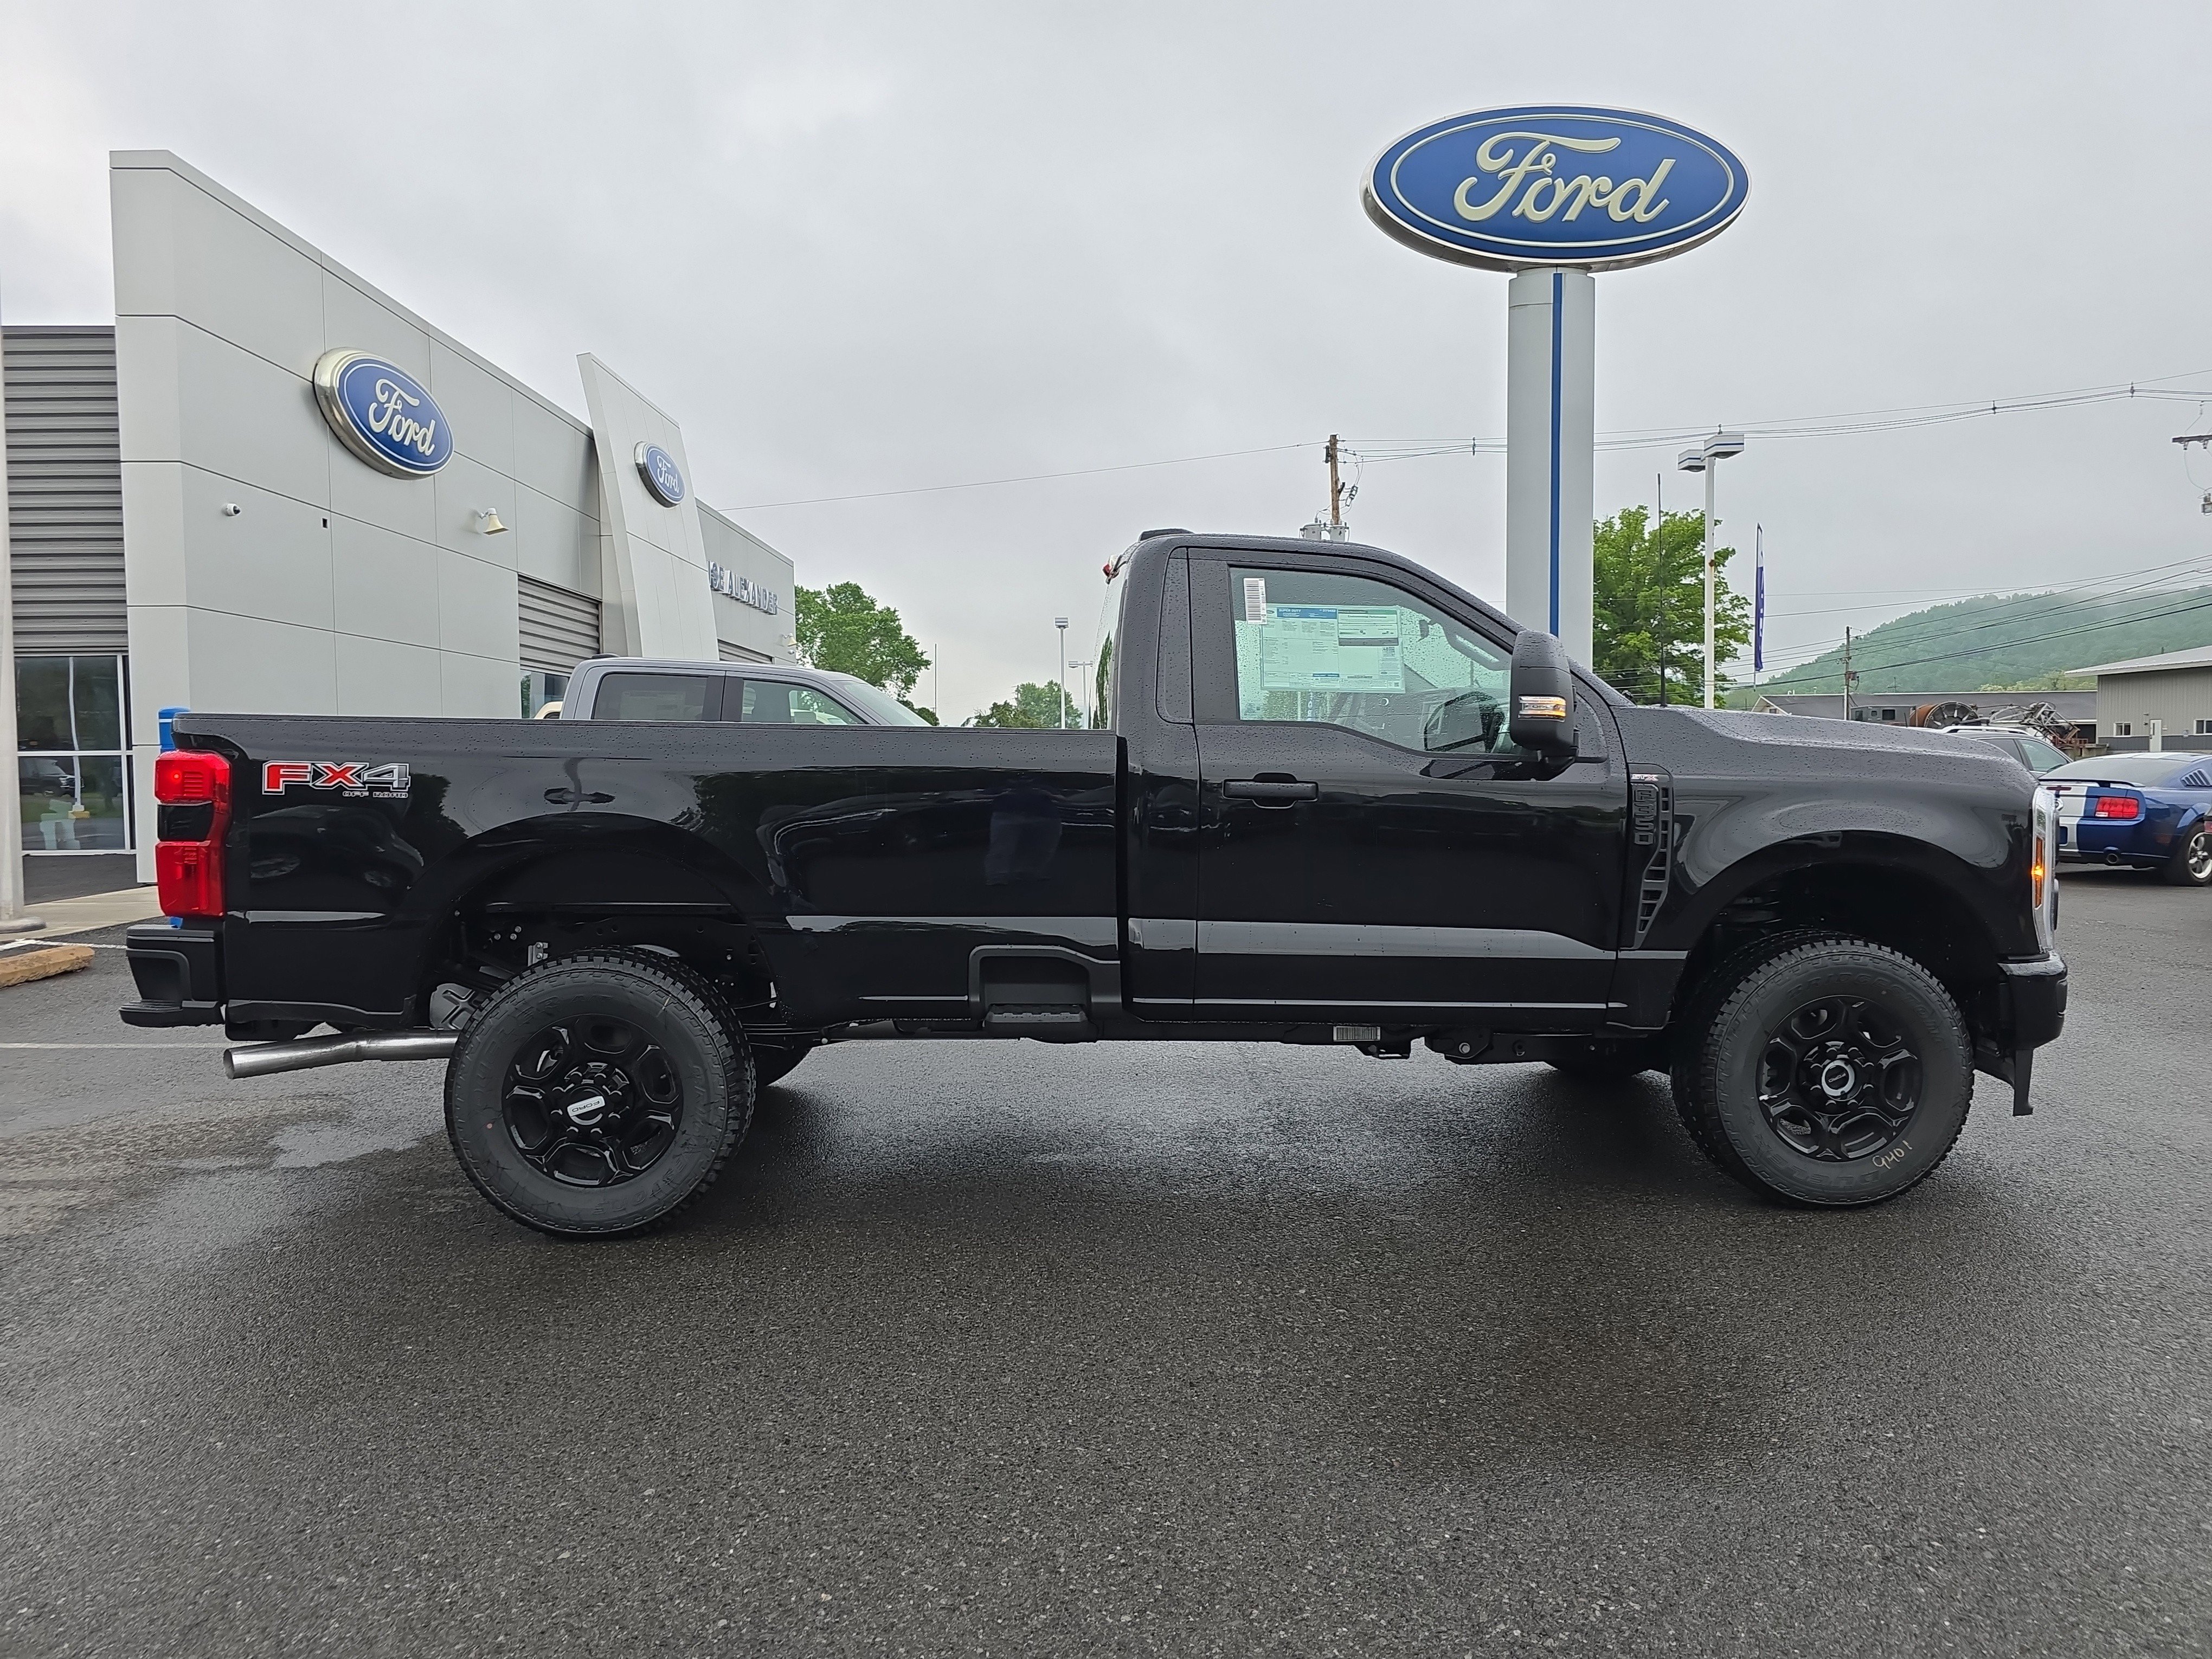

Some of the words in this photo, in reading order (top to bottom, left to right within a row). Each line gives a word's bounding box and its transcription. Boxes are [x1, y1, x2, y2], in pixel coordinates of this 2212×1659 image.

[1454, 132, 1676, 223] Ford
[368, 378, 435, 456] Ford
[657, 455, 679, 494] Ford
[724, 570, 778, 615] ALEXANDER
[262, 760, 411, 795] FX4
[571, 1101, 600, 1113] FORD
